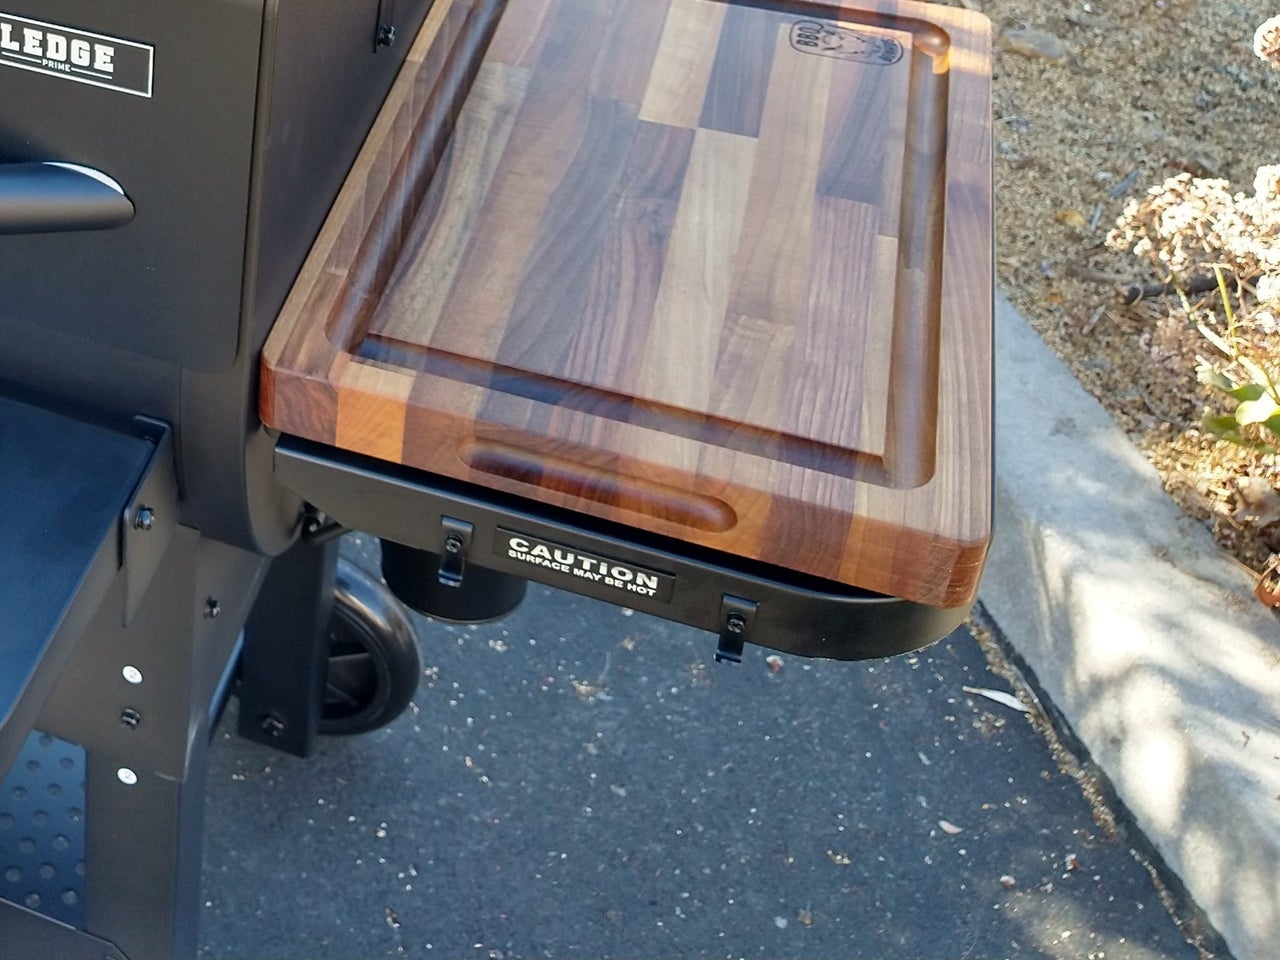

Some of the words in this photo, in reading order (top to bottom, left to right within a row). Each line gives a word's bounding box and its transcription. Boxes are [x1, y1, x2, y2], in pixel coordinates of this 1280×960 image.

[0, 22, 115, 73] LEDGE
[42, 58, 71, 72] PRIME
[508, 537, 659, 590] CAUTION
[508, 549, 570, 574] SURFACE
[573, 568, 602, 582] MAY
[604, 576, 624, 589] BE
[626, 582, 657, 597] HOT
